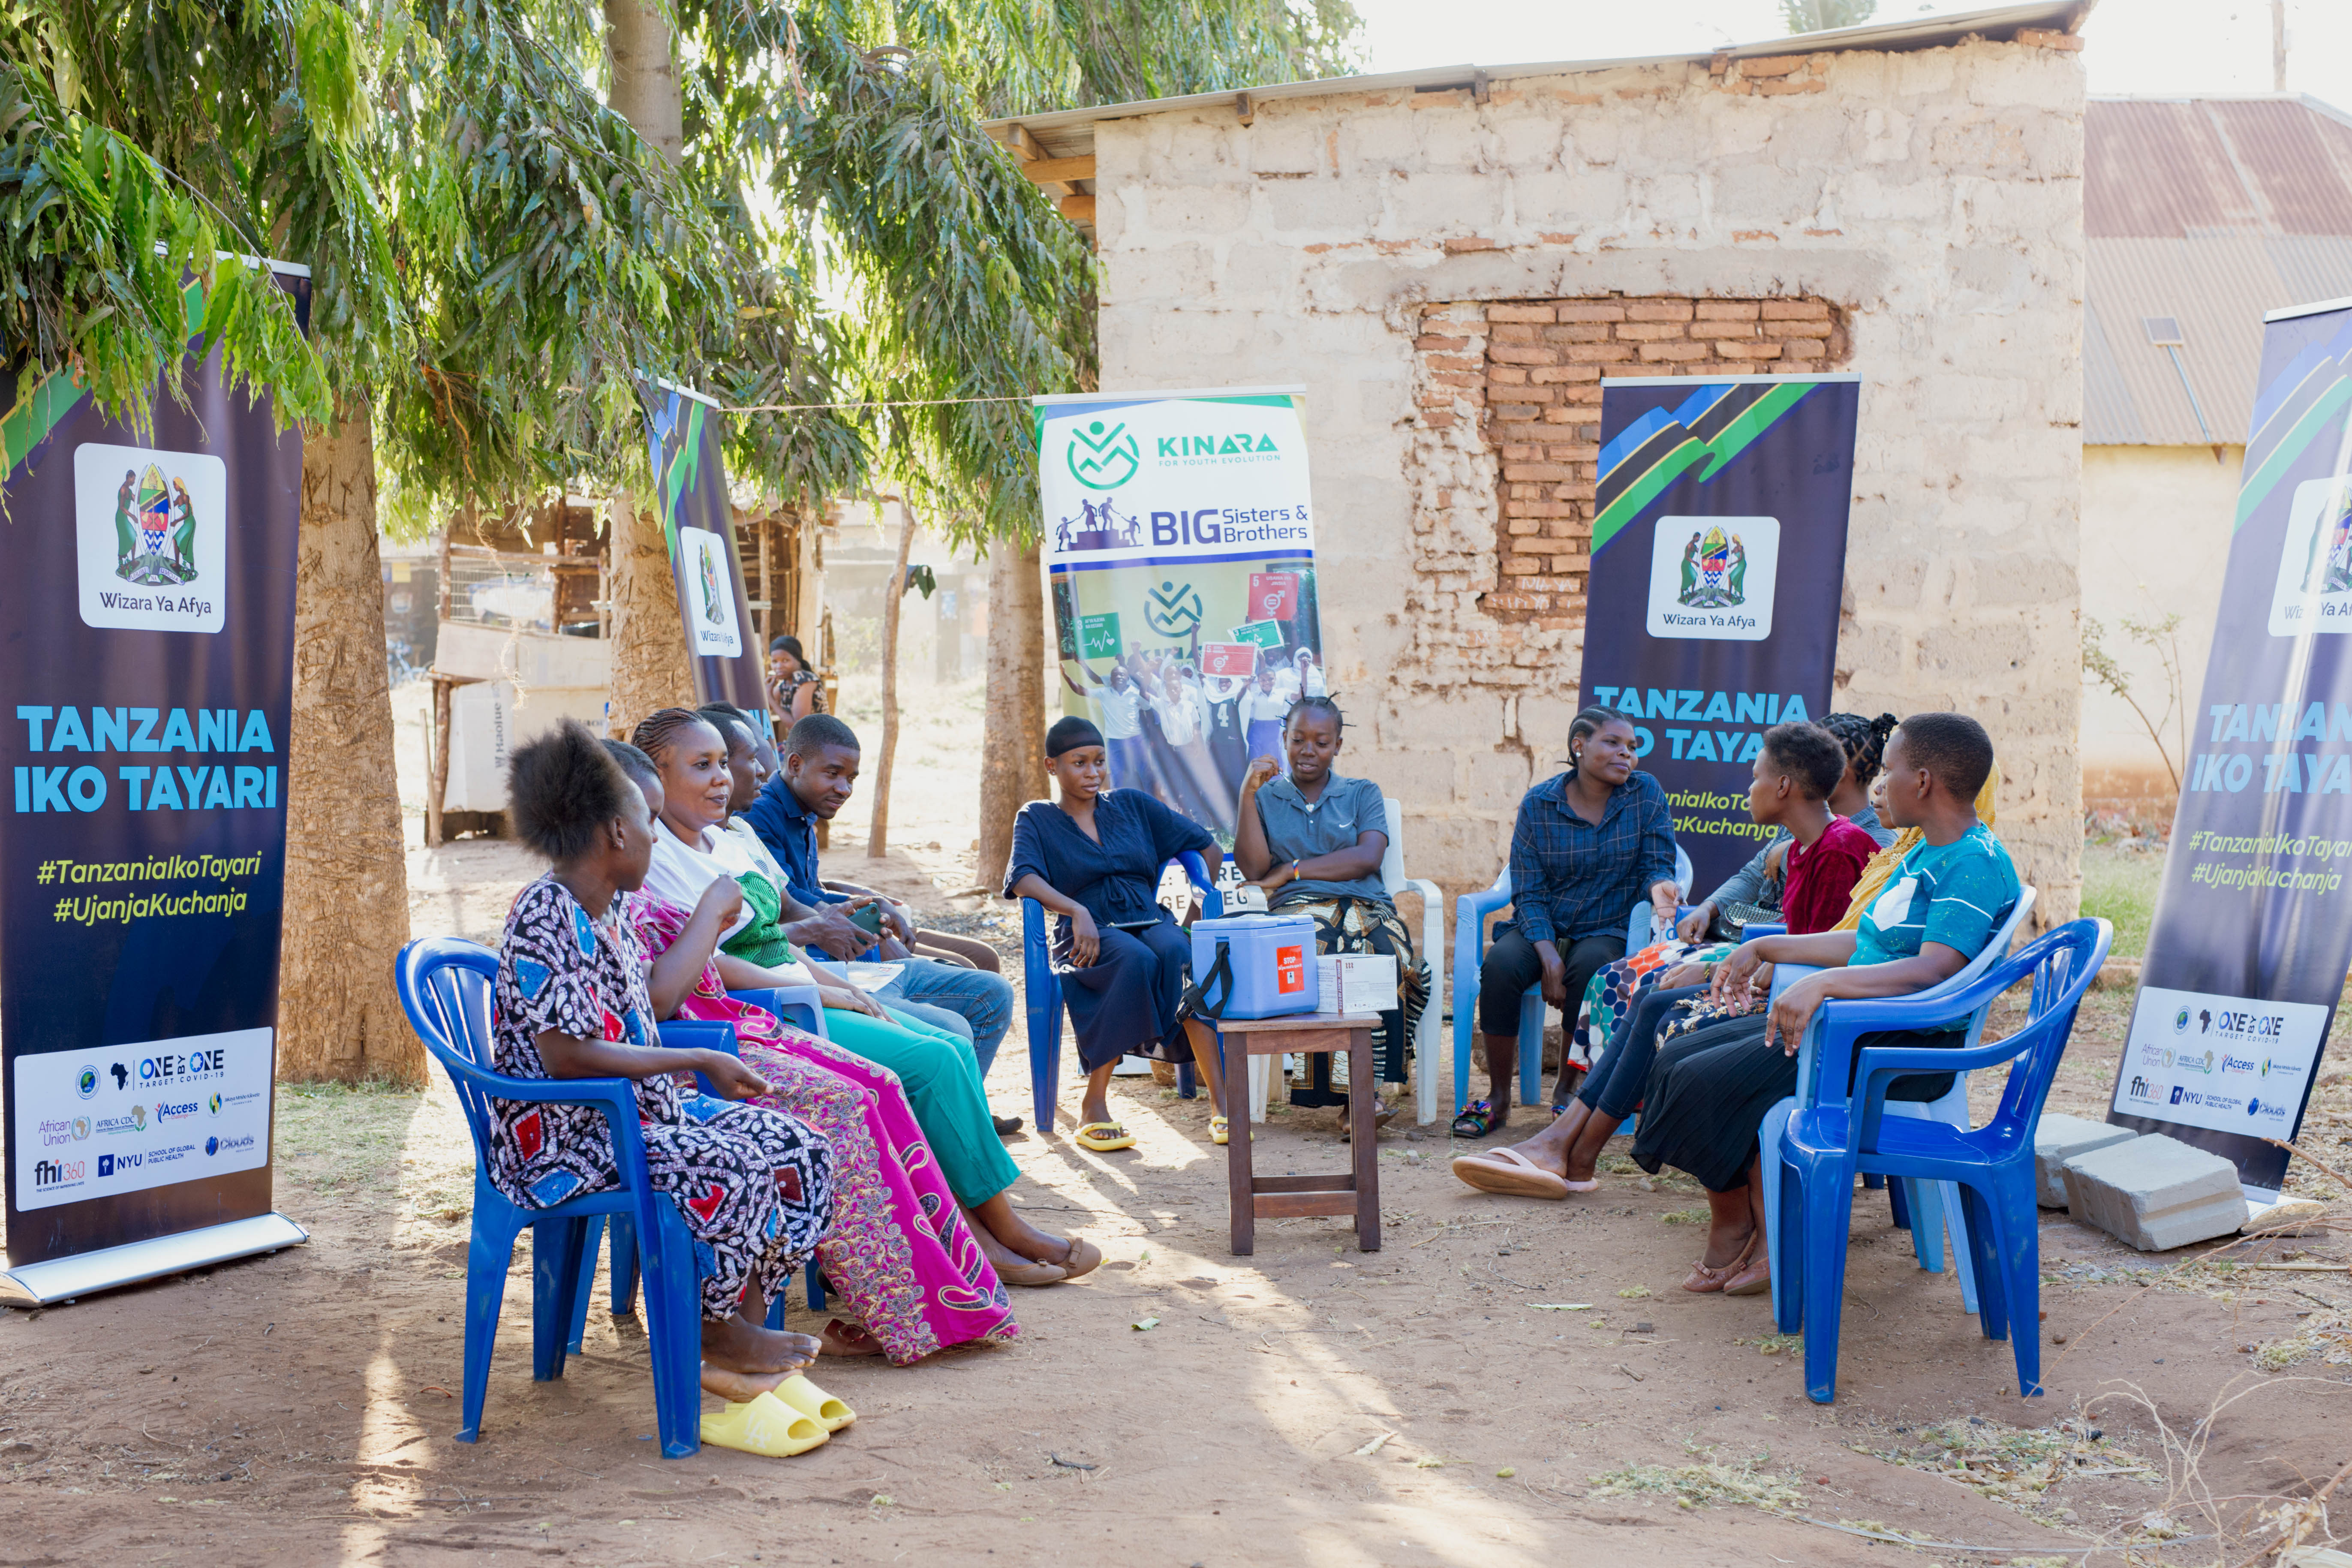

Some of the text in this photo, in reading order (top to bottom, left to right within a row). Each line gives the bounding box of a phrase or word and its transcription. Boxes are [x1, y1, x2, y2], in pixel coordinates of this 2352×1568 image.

[1158, 433, 1278, 457] KINARA
[1222, 455, 1281, 464] EVOLUTION
[1223, 505, 1308, 524] Sisters &
[1151, 509, 1221, 546] BIG
[1224, 524, 1308, 543] Brothers
[160, 567, 178, 582] UMOJA
[1253, 576, 1259, 587] 5
[99, 592, 211, 617] Wizara Ya Afya
[2321, 602, 2335, 616] Ya
[1077, 620, 1083, 630] 3
[1663, 614, 1756, 629] Wizara Ya Afya
[1594, 686, 1809, 725] TANZANIA
[1217, 704, 1229, 727] 4
[2209, 701, 2352, 742] TANZAN
[17, 705, 275, 752] TANZANIA
[1666, 728, 1765, 763] TAYA
[2190, 753, 2352, 794] IKO TAYA
[14, 765, 277, 813] IKO TAYARI
[36, 850, 262, 885] #TanzaniaIkoTayari
[2192, 862, 2343, 895] #UjanjaKuchanja
[53, 887, 247, 927] #UjanjaKuchanja
[1284, 956, 1296, 964] STOP
[2219, 1011, 2284, 1036] ONE BY ONE
[2215, 1031, 2279, 1044] TARGET COVID-19
[2141, 1043, 2163, 1056] African
[140, 1049, 224, 1080] ONE BY ONE
[2143, 1055, 2160, 1067] Union
[2195, 1057, 2205, 1065] CDC
[2226, 1056, 2254, 1071] Access
[140, 1071, 224, 1089] TARGET COVID-19
[2183, 1091, 2203, 1105] NYU
[163, 1102, 198, 1116] Access
[2259, 1102, 2286, 1117] Clouds
[39, 1120, 71, 1134] African
[96, 1116, 135, 1128] AFRICA CDC
[44, 1132, 70, 1146] Union
[220, 1133, 254, 1151] Clouds
[148, 1149, 167, 1158] SCHOOL
[177, 1144, 195, 1153] GLOBAL
[117, 1154, 142, 1170] NYU
[148, 1153, 184, 1165] PUBLIC HEALTH
